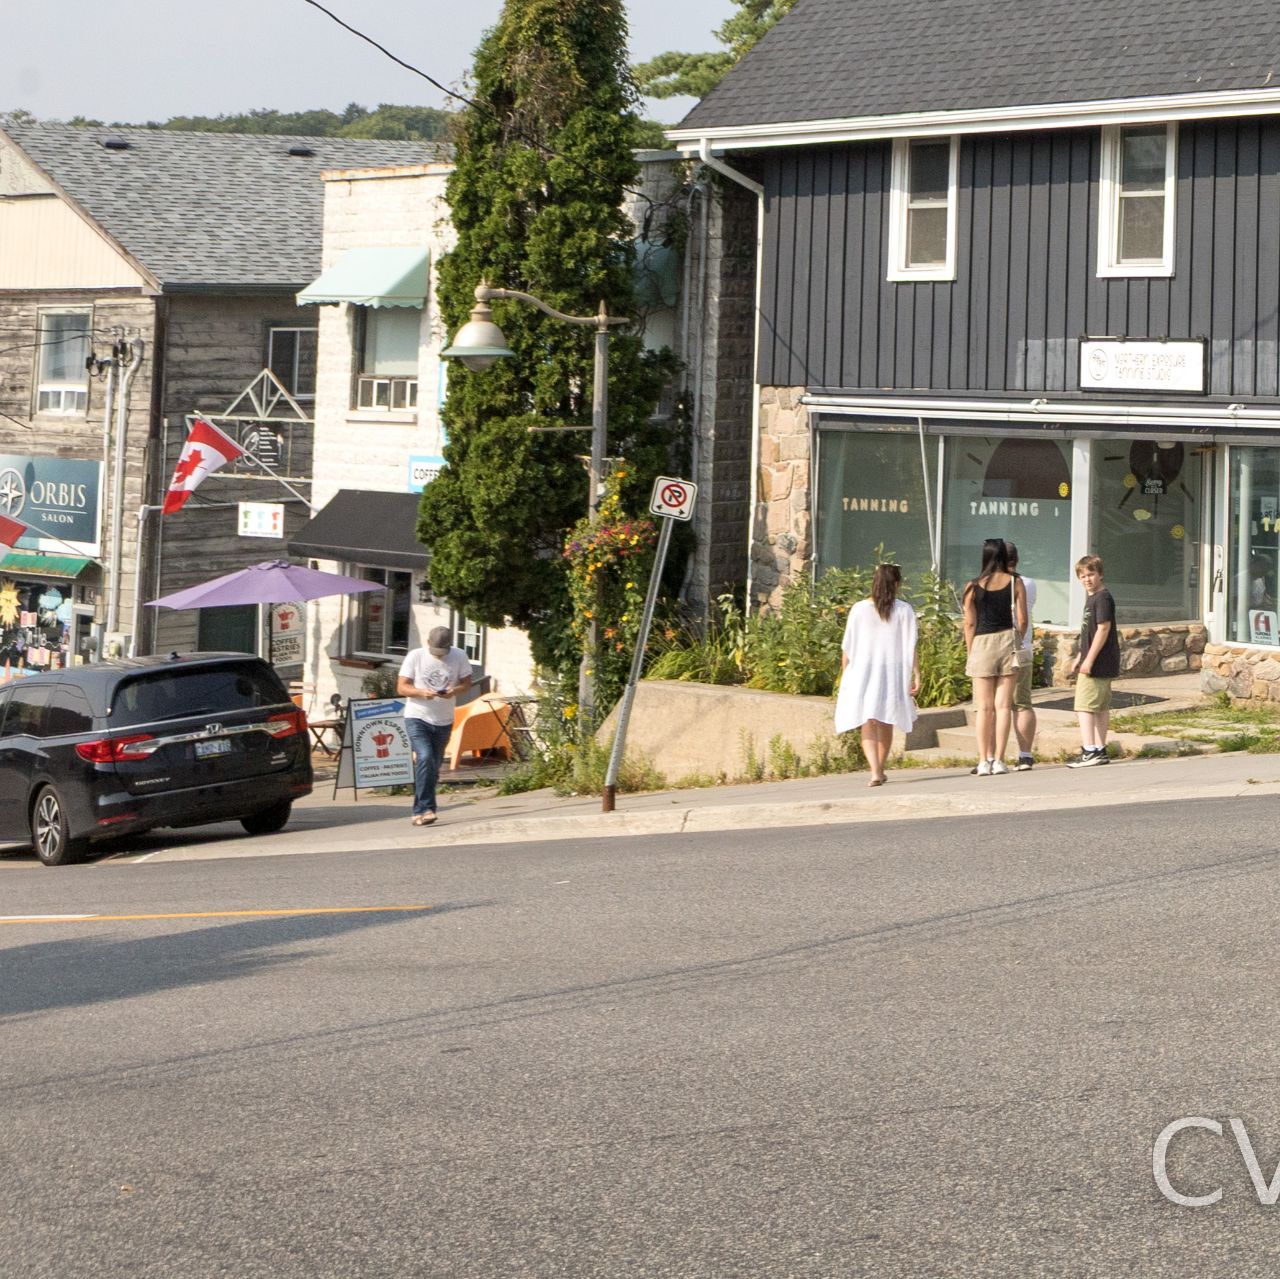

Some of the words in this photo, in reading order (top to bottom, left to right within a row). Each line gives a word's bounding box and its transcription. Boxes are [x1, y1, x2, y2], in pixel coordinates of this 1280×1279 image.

[30, 480, 87, 508] ORBIS
[842, 497, 909, 513] TANNING
[970, 501, 1039, 517] TANNING
[41, 512, 74, 524] SALON
[271, 644, 301, 653] ASTRIES
[355, 719, 384, 753] DOWNTOWN
[384, 719, 410, 749] ESPRESSO
